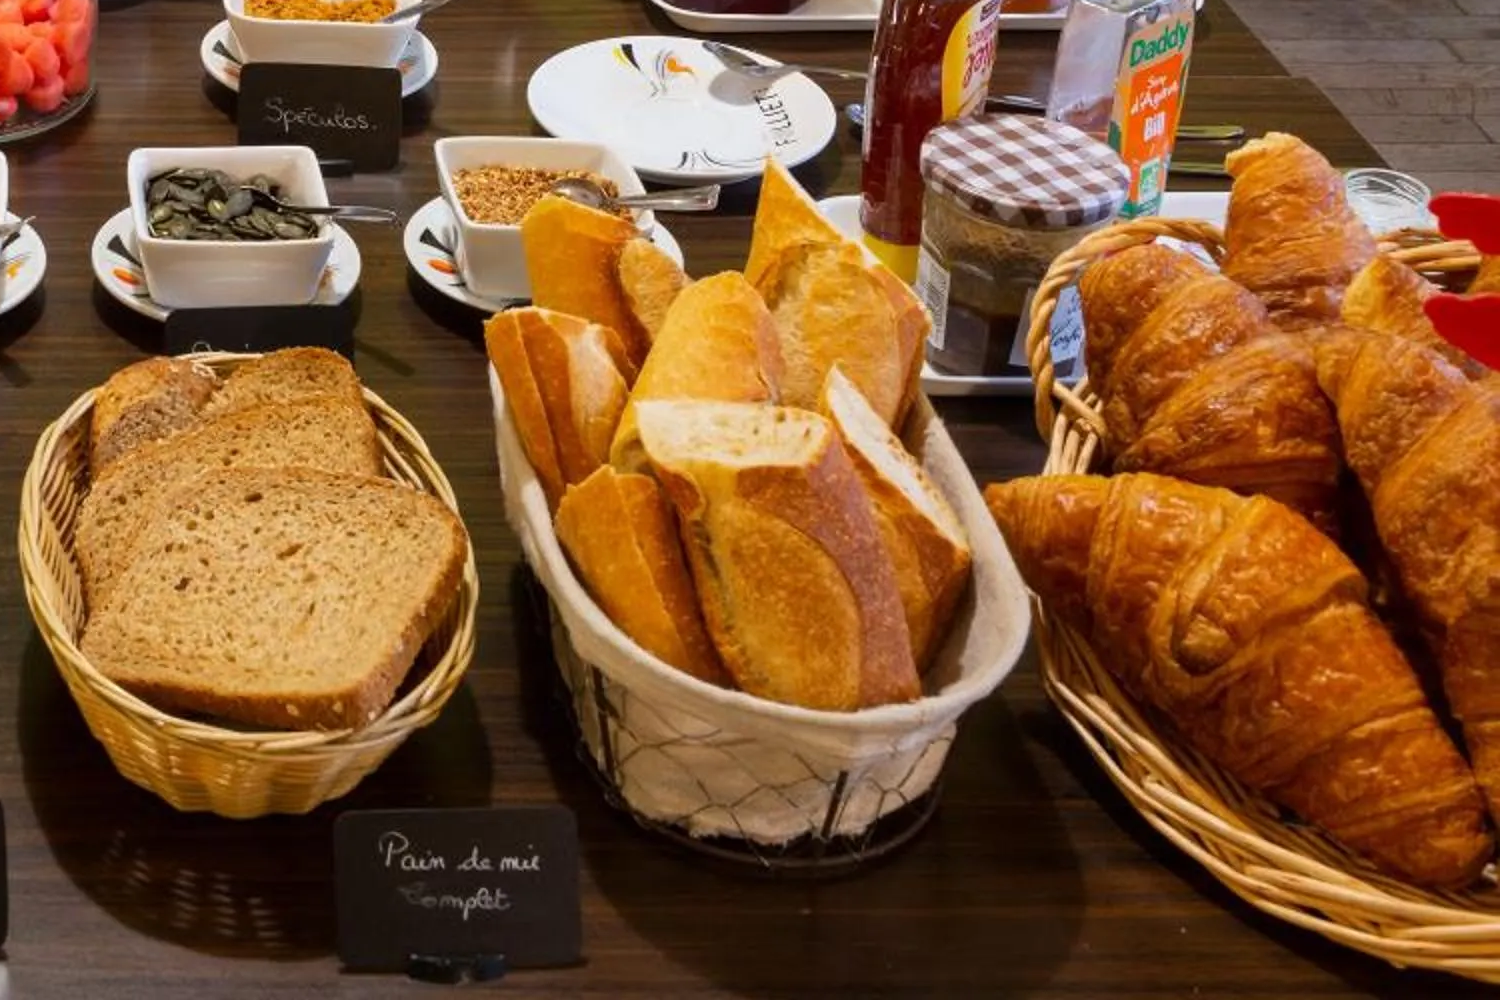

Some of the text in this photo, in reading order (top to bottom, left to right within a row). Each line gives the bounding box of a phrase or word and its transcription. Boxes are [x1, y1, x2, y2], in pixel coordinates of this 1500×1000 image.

[1129, 20, 1189, 68] Daddy
[378, 831, 540, 871] Pain de mie
